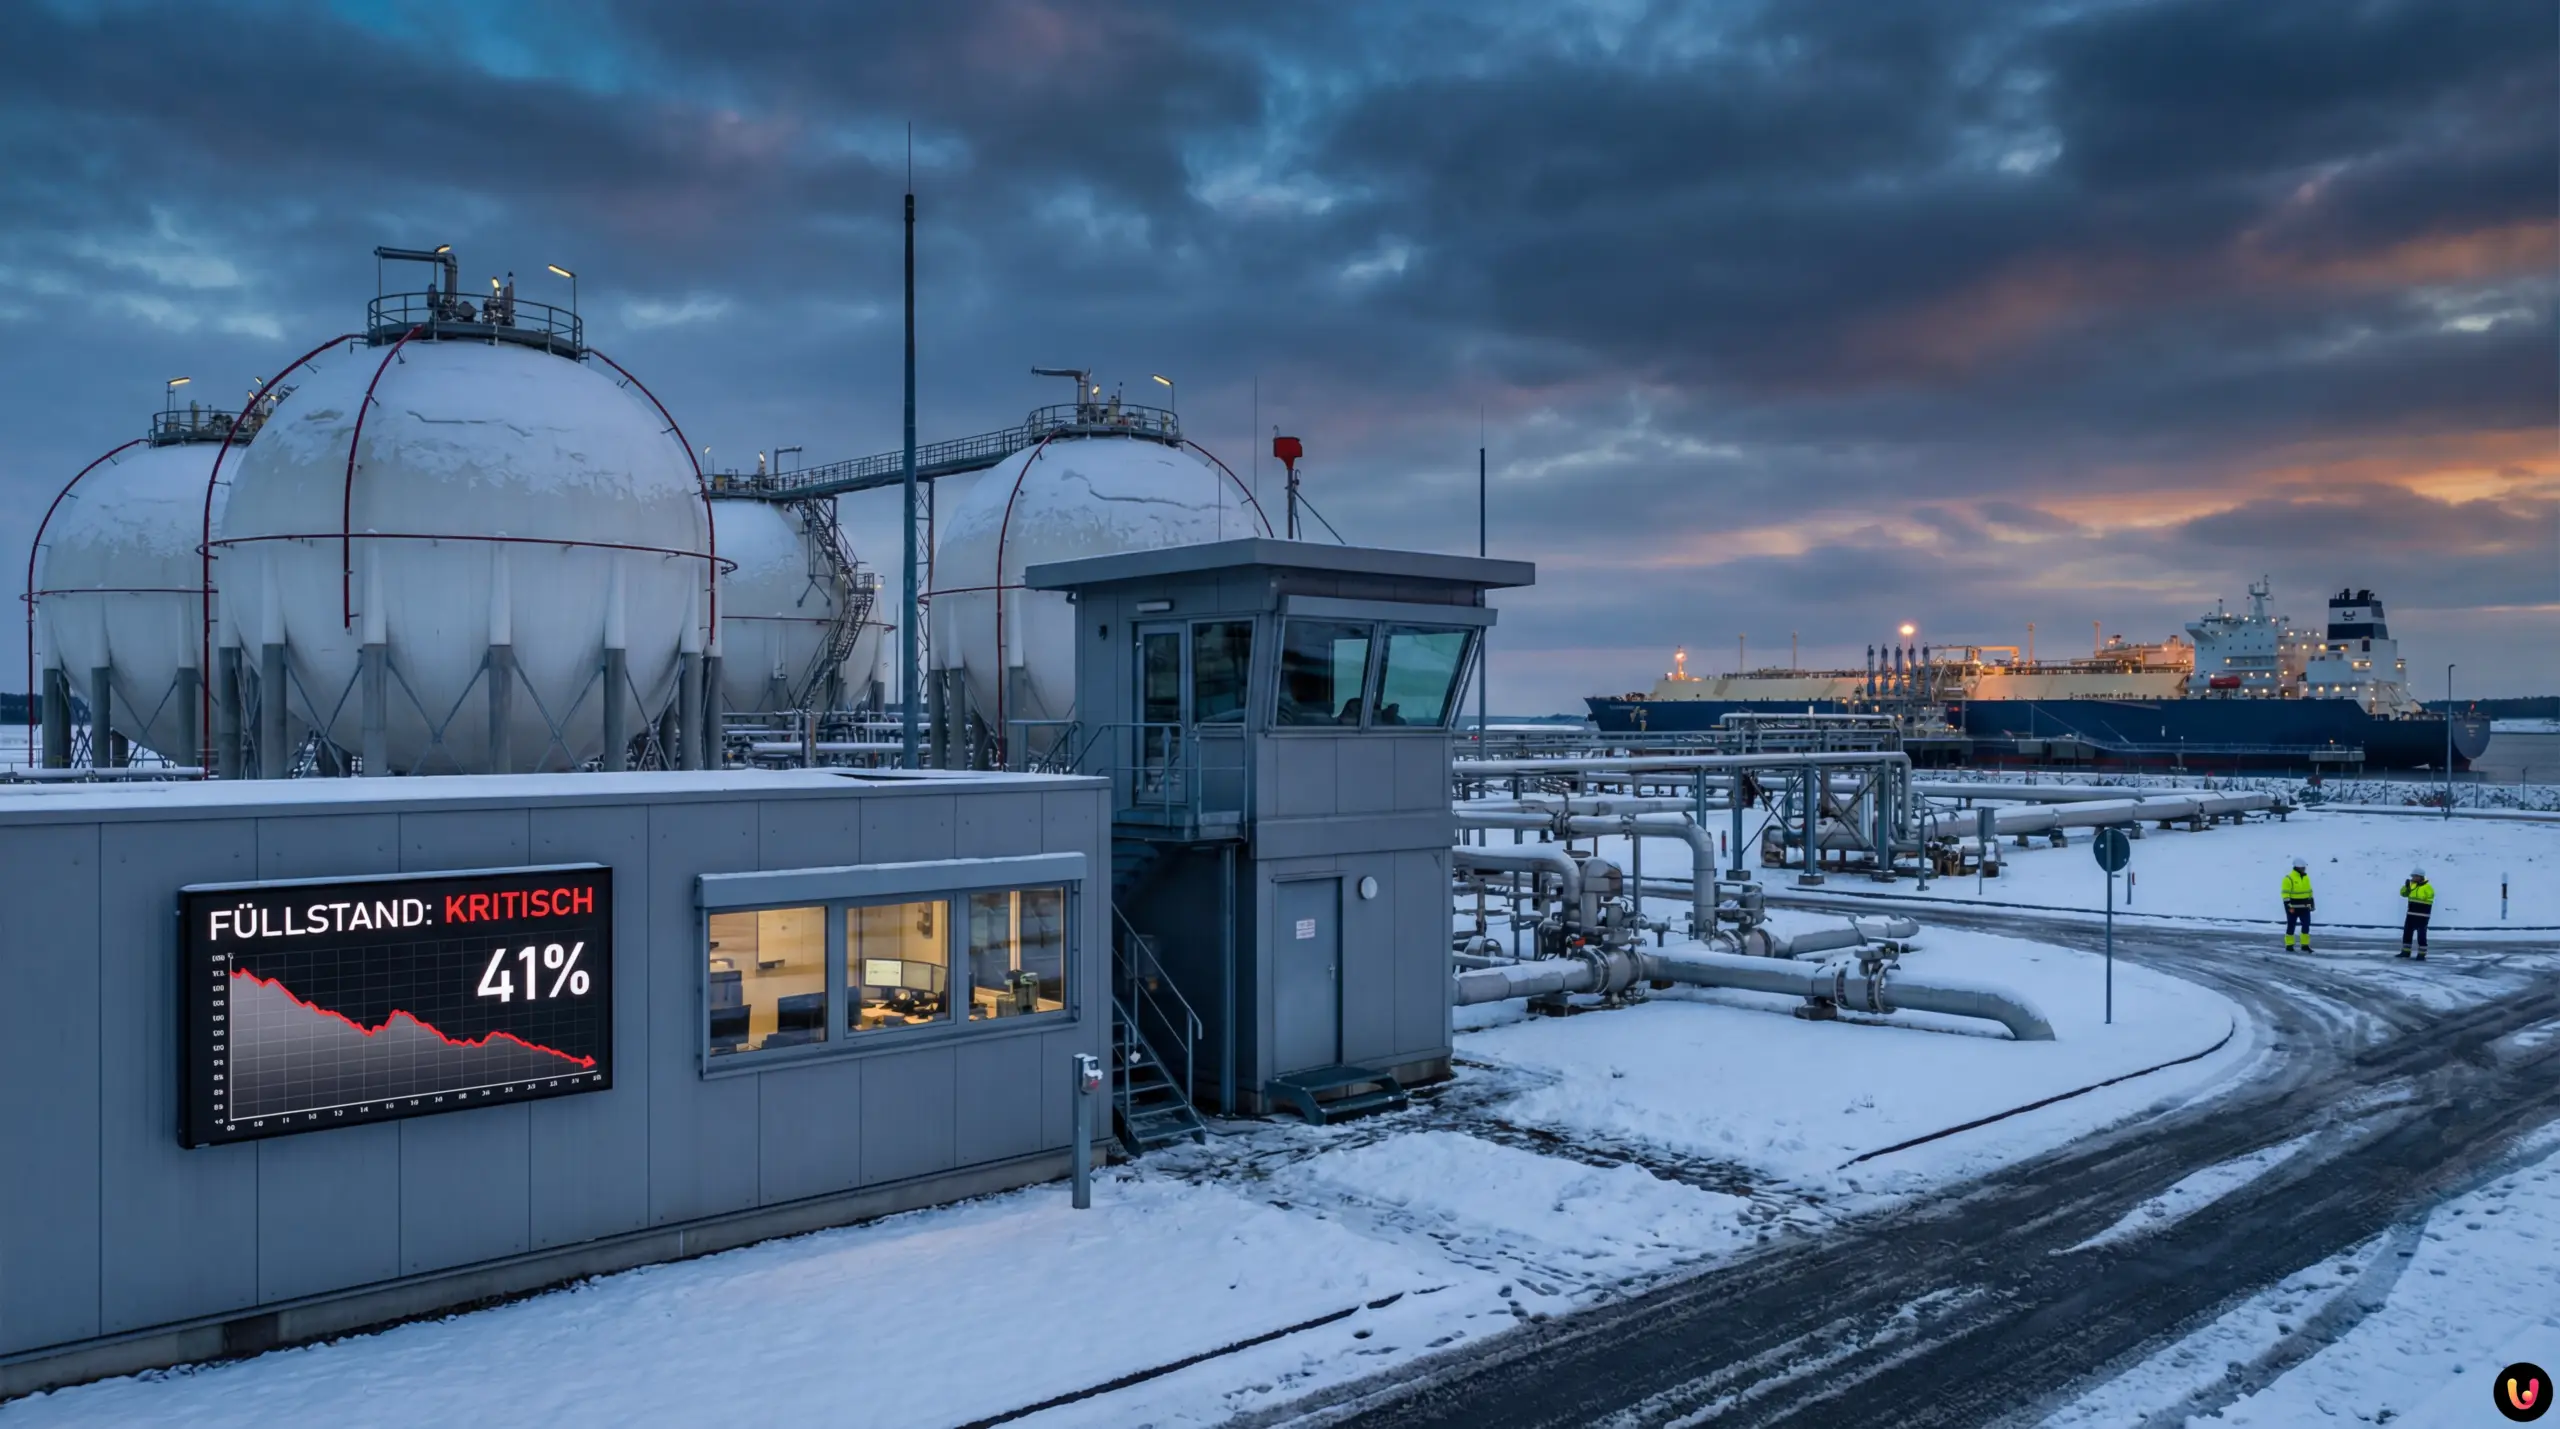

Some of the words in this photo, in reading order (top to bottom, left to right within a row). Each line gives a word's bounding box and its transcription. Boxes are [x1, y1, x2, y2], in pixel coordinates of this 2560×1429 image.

[210, 898, 433, 941] FÜLLSTAND:
[445, 886, 593, 924] KRITISCH
[476, 941, 590, 1003] 41%
